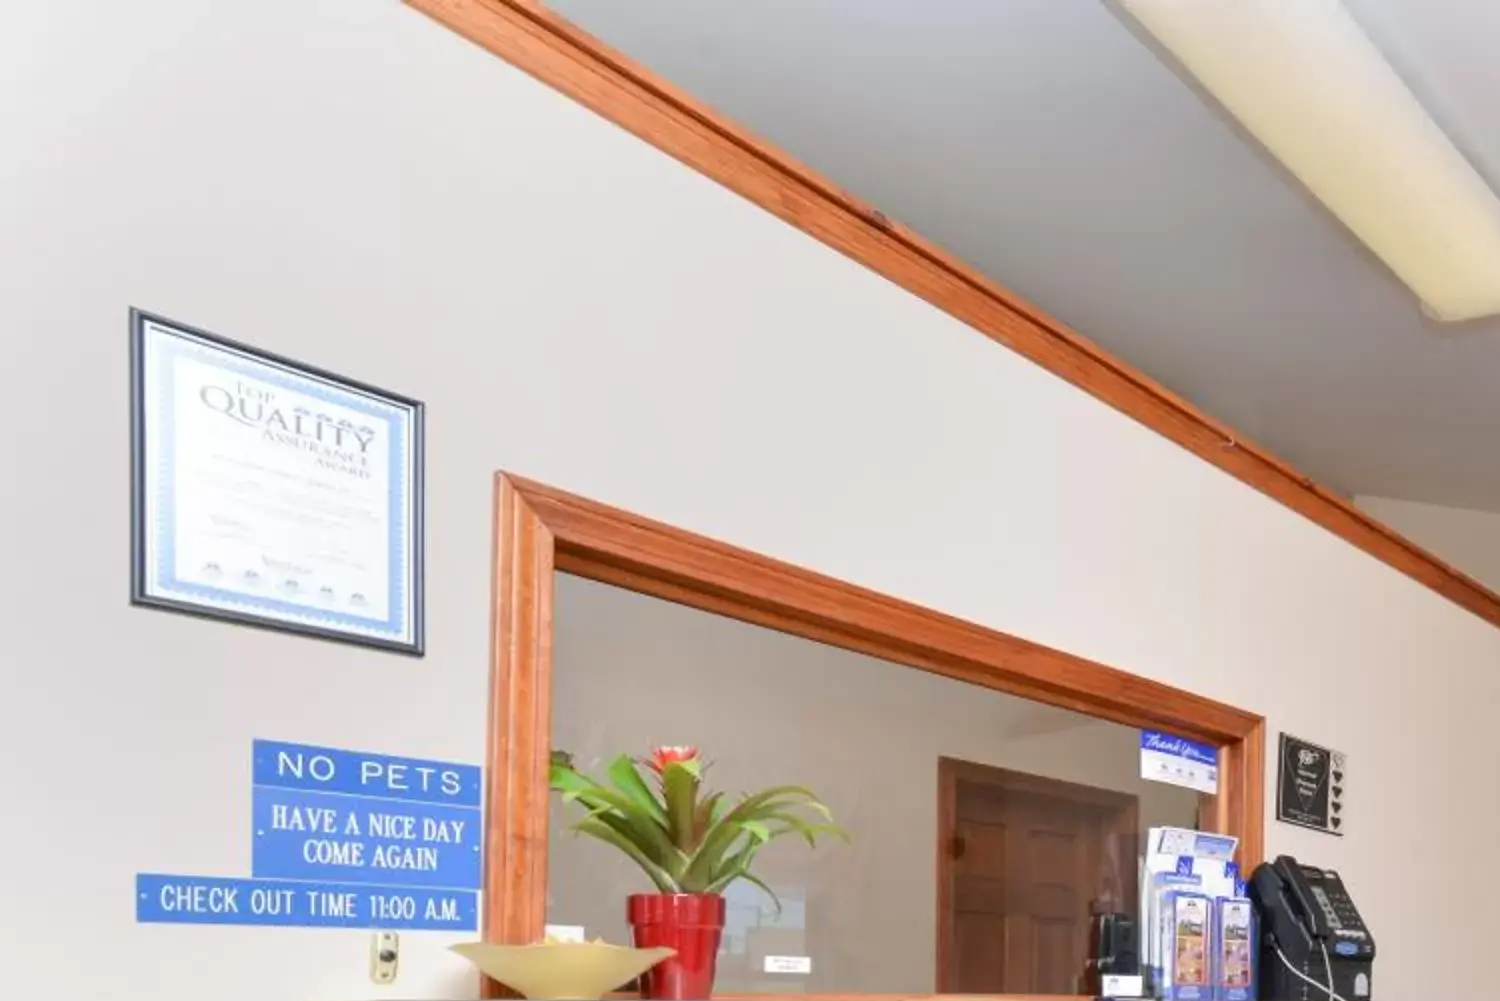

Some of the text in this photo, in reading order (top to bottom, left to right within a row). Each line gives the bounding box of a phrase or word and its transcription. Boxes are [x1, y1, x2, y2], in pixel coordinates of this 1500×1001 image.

[200, 385, 375, 453] QUALITY
[263, 428, 368, 467] ASSURANCE
[315, 458, 371, 480] AWARD
[278, 751, 462, 795] NO PETS
[272, 804, 465, 844] HAVE A NICE DAY
[302, 839, 438, 872] COME AGAIN
[159, 884, 461, 921] CHECK OUT TIME 11:00 A.M.
